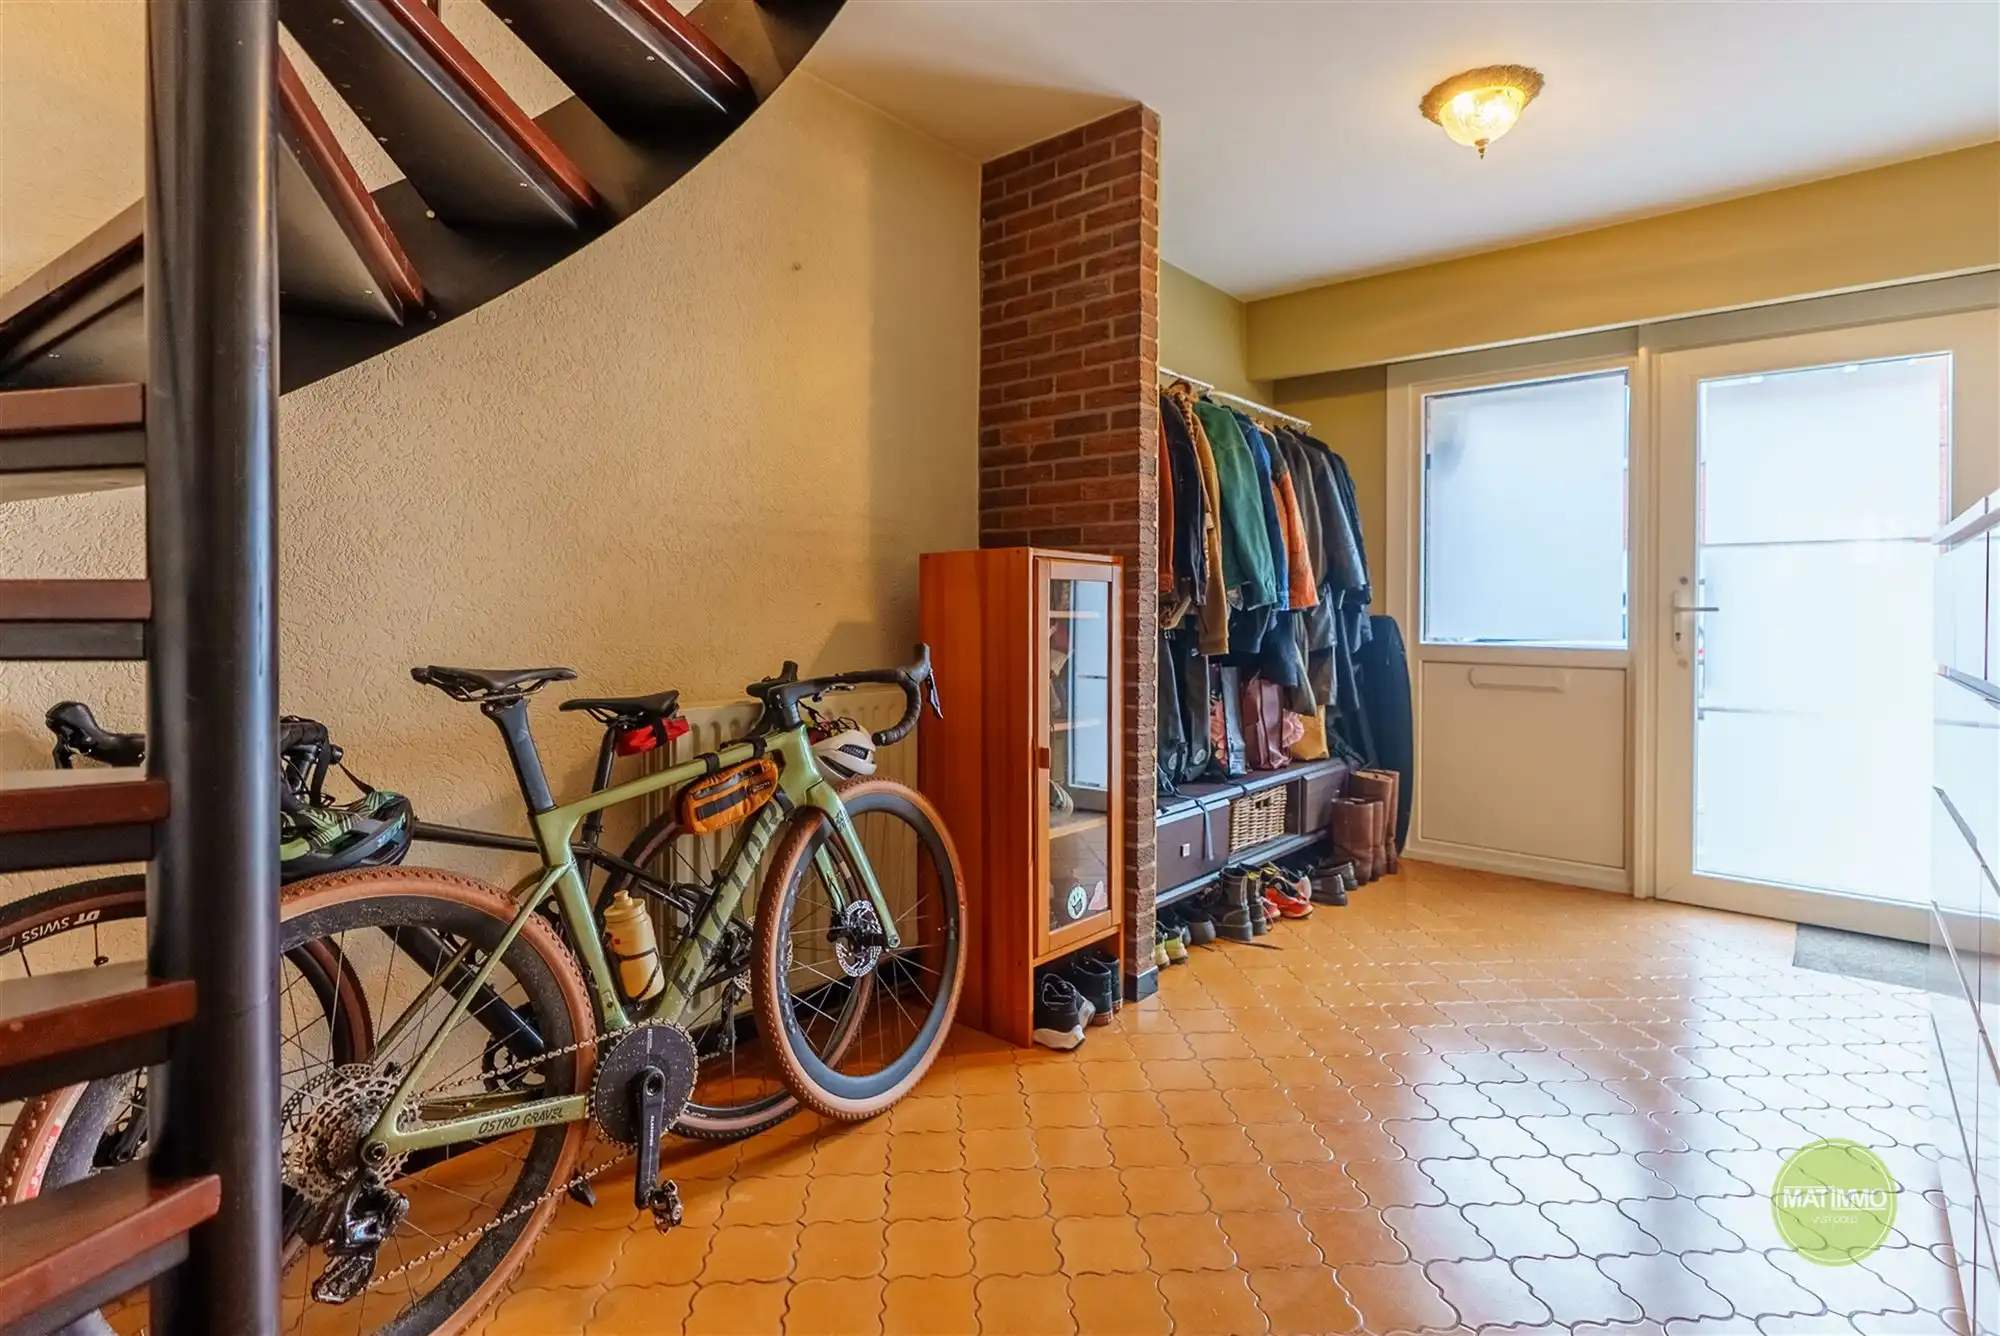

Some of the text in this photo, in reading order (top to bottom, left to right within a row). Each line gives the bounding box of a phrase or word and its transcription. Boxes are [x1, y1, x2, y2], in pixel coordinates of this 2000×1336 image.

[22, 910, 100, 943] DT SWISS
[479, 1107, 563, 1134] OSTRO GRAVEL
